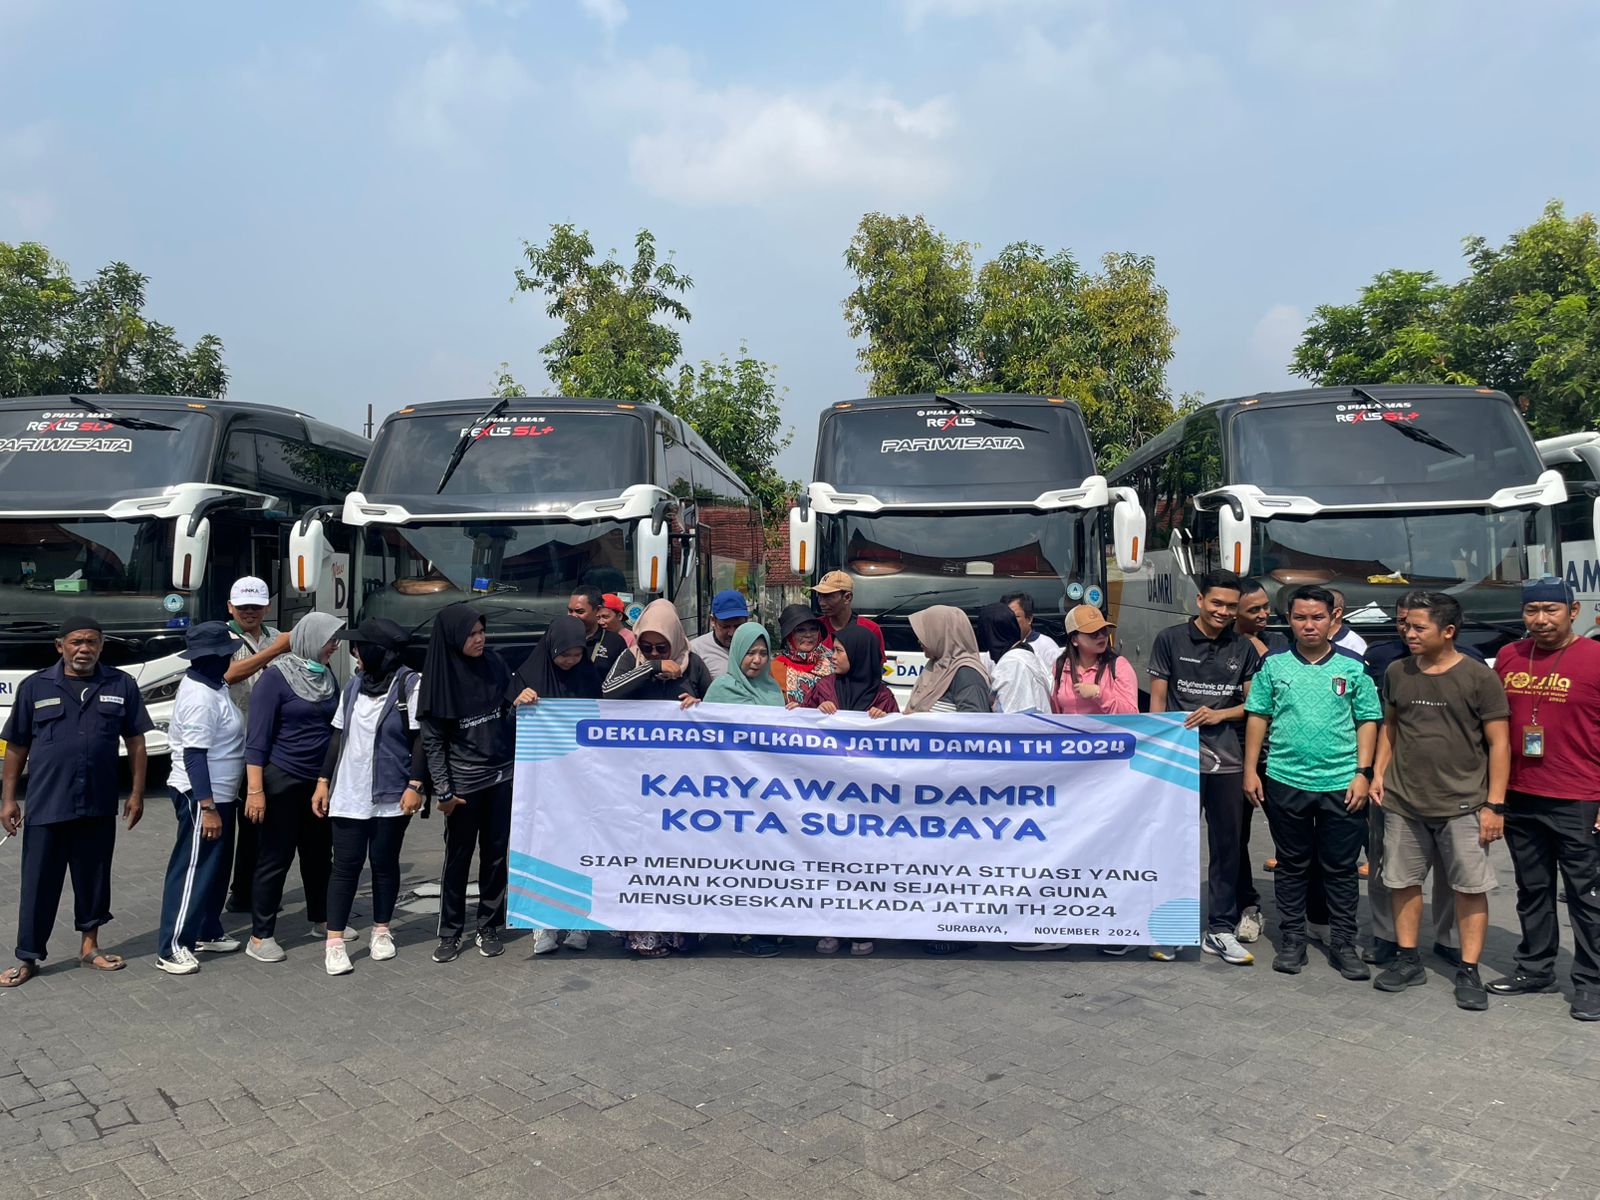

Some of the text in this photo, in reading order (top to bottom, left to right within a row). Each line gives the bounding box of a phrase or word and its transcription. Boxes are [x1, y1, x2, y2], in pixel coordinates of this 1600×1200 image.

[26, 418, 79, 433] REXUS
[927, 416, 976, 430] REXUS
[1336, 411, 1382, 424] REXUS
[512, 425, 555, 437] SL+
[881, 437, 1025, 453] PARIWISATA
[1147, 573, 1173, 605] DAMRI
[587, 726, 1126, 755] DEKLARASI PILKADA JATIM DAMAI TH 2024
[641, 773, 1056, 807] KARYAWAN DAMRI
[662, 808, 1047, 842] KOTA SURABAYA
[579, 855, 1158, 882] SIAP MENDUKUNG TERCIPTANYA SITUASI YANG
[628, 874, 1108, 899] AMAN KONDUSIF DAN SEJAHTARA GUNA
[619, 892, 1117, 917] MENSUKSESKAN PILKADA JATIM TH 2024
[937, 924, 1141, 937] SURABAYA, NOVEMBER 2024
